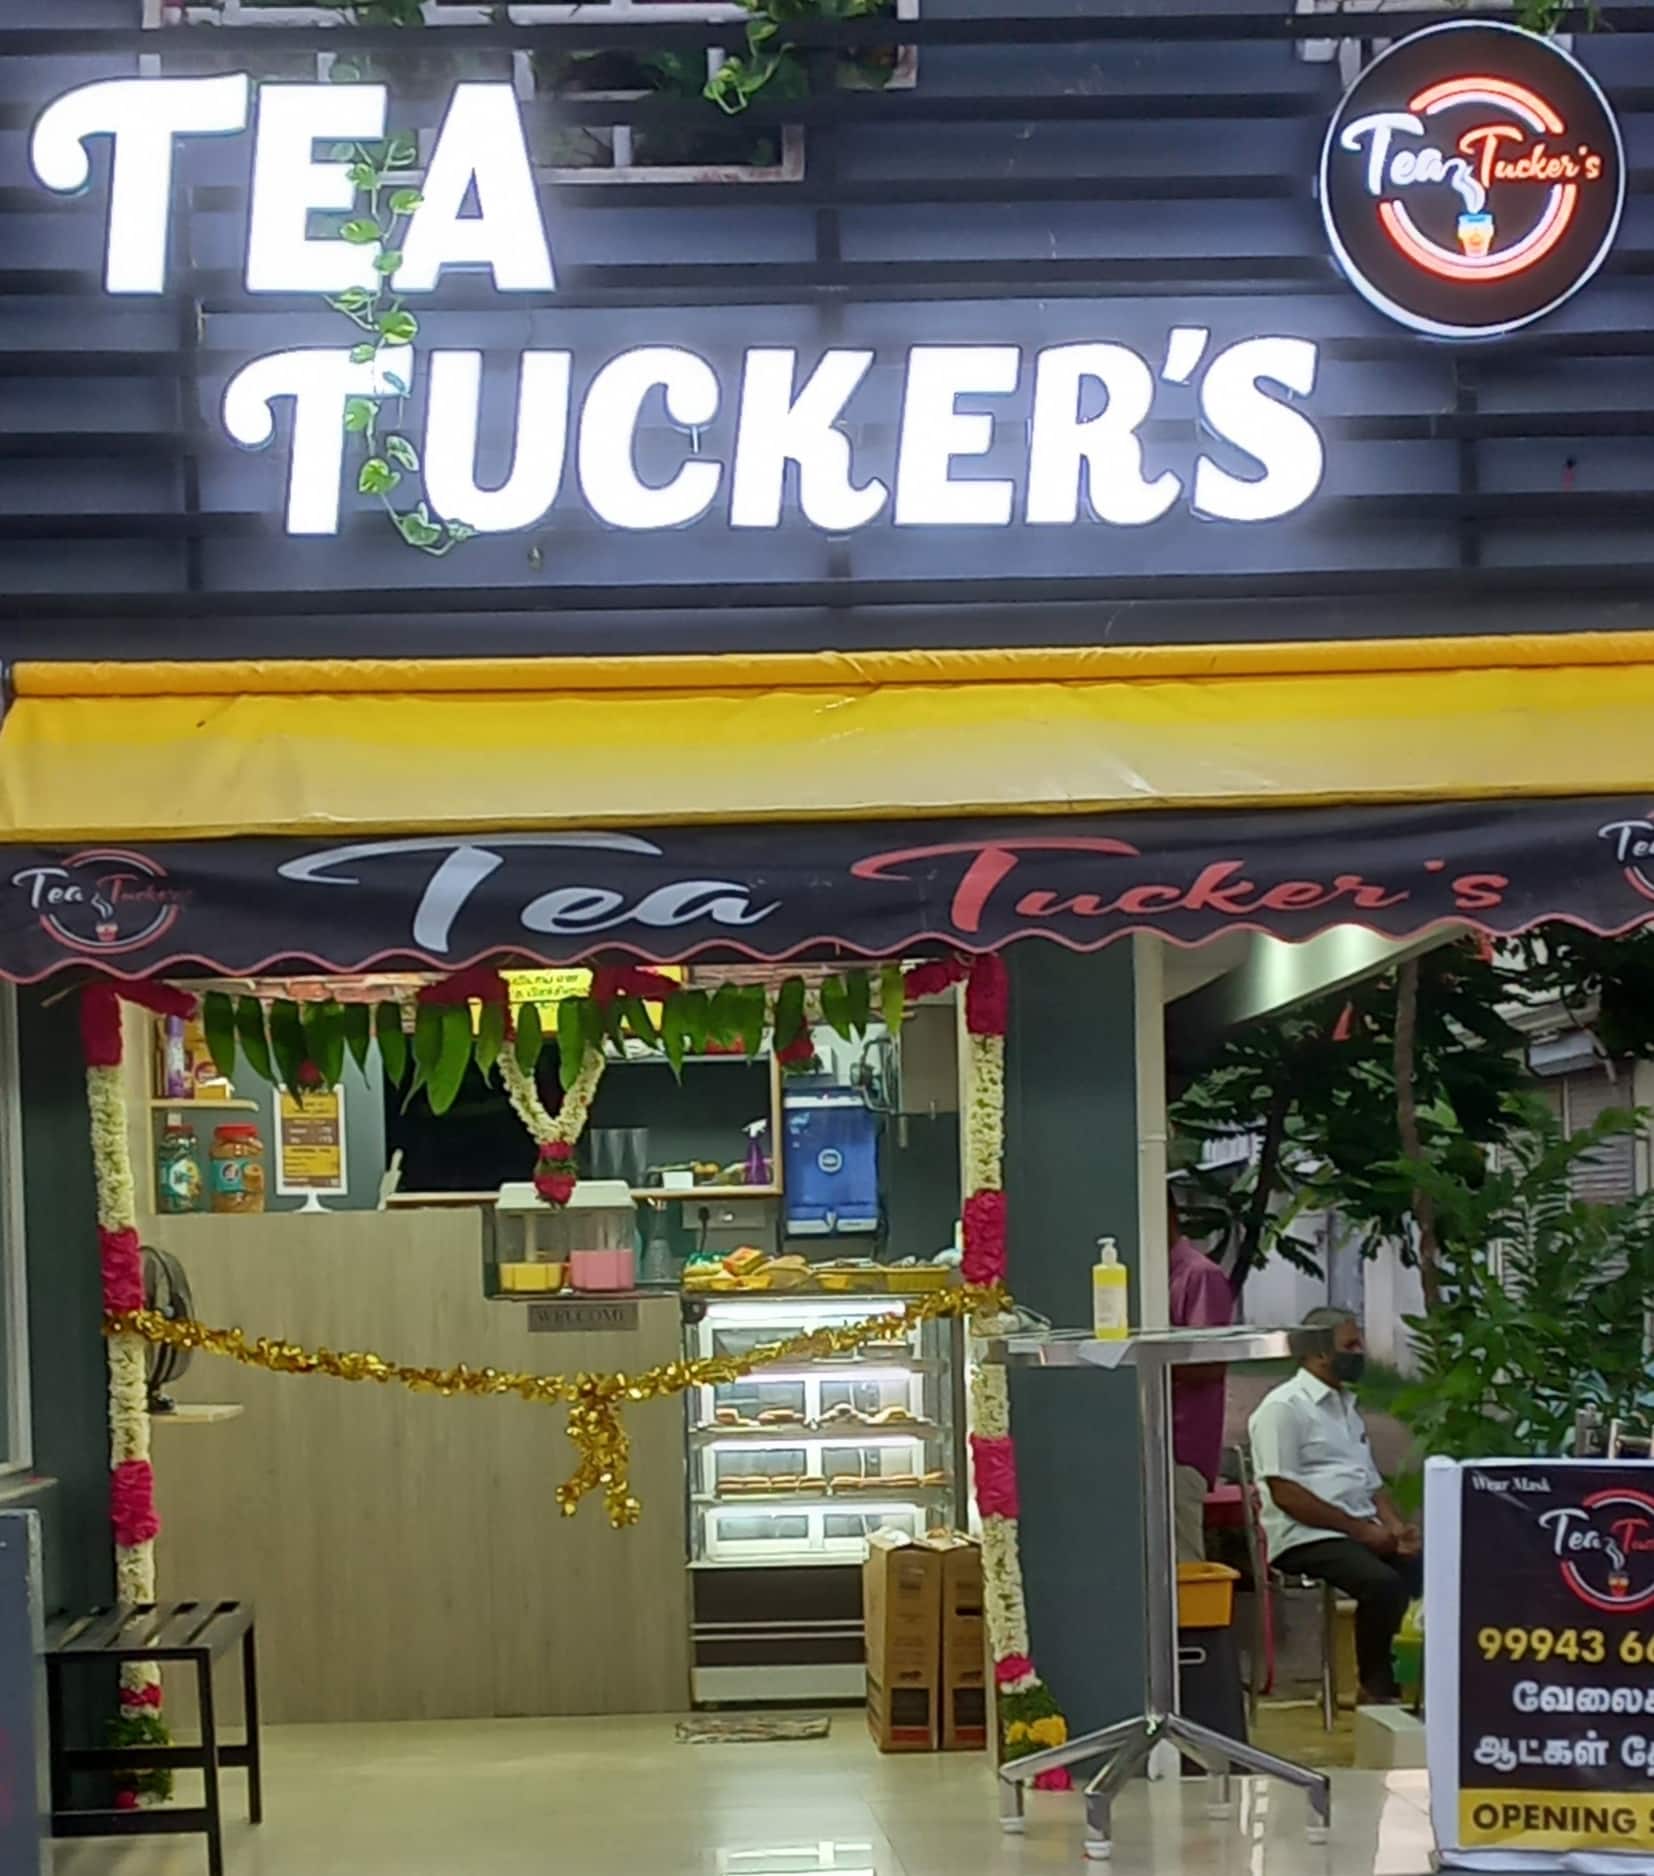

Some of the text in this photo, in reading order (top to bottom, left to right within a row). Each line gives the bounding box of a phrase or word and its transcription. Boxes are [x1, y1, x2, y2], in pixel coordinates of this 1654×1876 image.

[1340, 112, 1601, 196] Tea Tucker's
[31, 74, 556, 294] TEA
[223, 326, 1324, 535] TUCKER'S
[1598, 820, 1654, 861] Te
[12, 867, 83, 908] Tea
[277, 831, 783, 953] Tea
[1512, 1477, 1551, 1492] Mask
[1538, 1508, 1601, 1555] Tea
[1478, 1627, 1605, 1662] 99943
[1474, 1729, 1610, 1772] ஆட்கள்
[1473, 1803, 1637, 1834] OPENING
